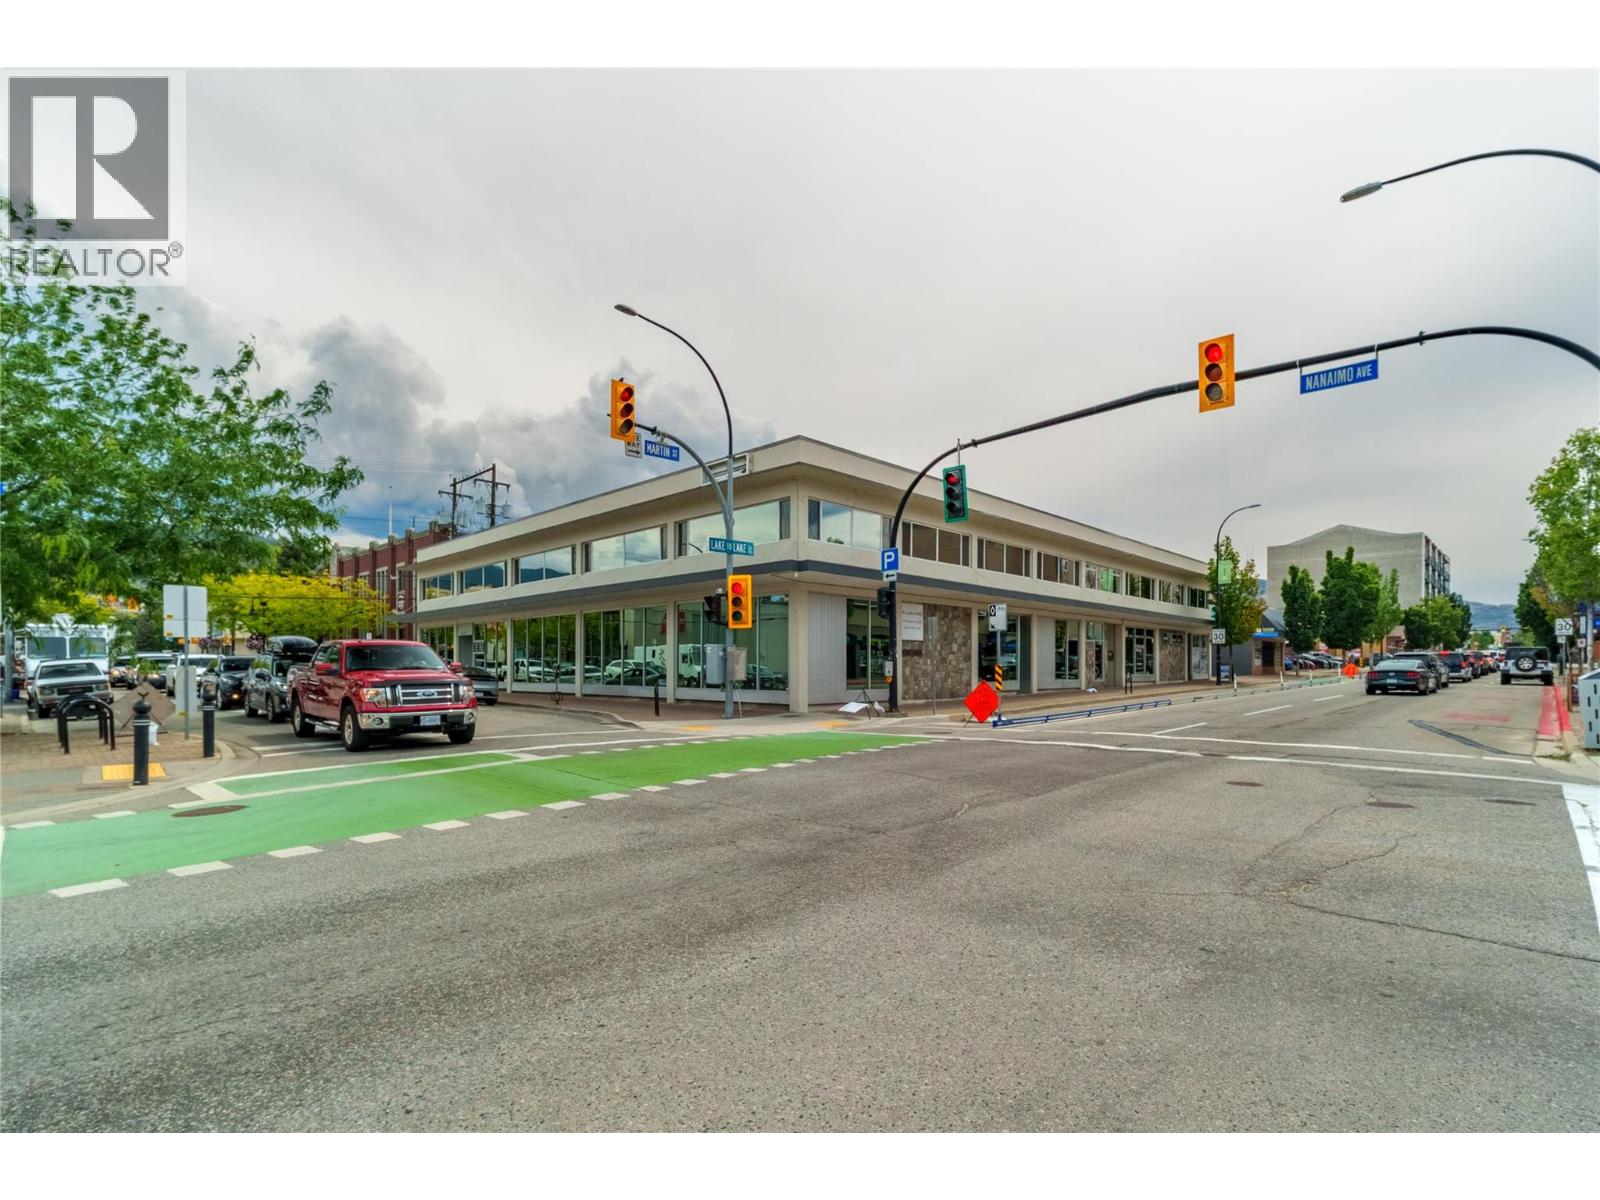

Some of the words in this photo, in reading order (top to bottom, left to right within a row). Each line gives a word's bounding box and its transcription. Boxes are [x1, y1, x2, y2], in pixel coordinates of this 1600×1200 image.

[1305, 366, 1354, 391] NANAIMO
[1356, 364, 1373, 379] AVE
[646, 441, 670, 458] MARTIN
[671, 449, 679, 458] ST
[710, 539, 726, 551] LAKE
[733, 542, 747, 553] LAKE
[884, 551, 896, 570] P
[1557, 623, 1571, 631] 30
[1212, 632, 1224, 641] 30
